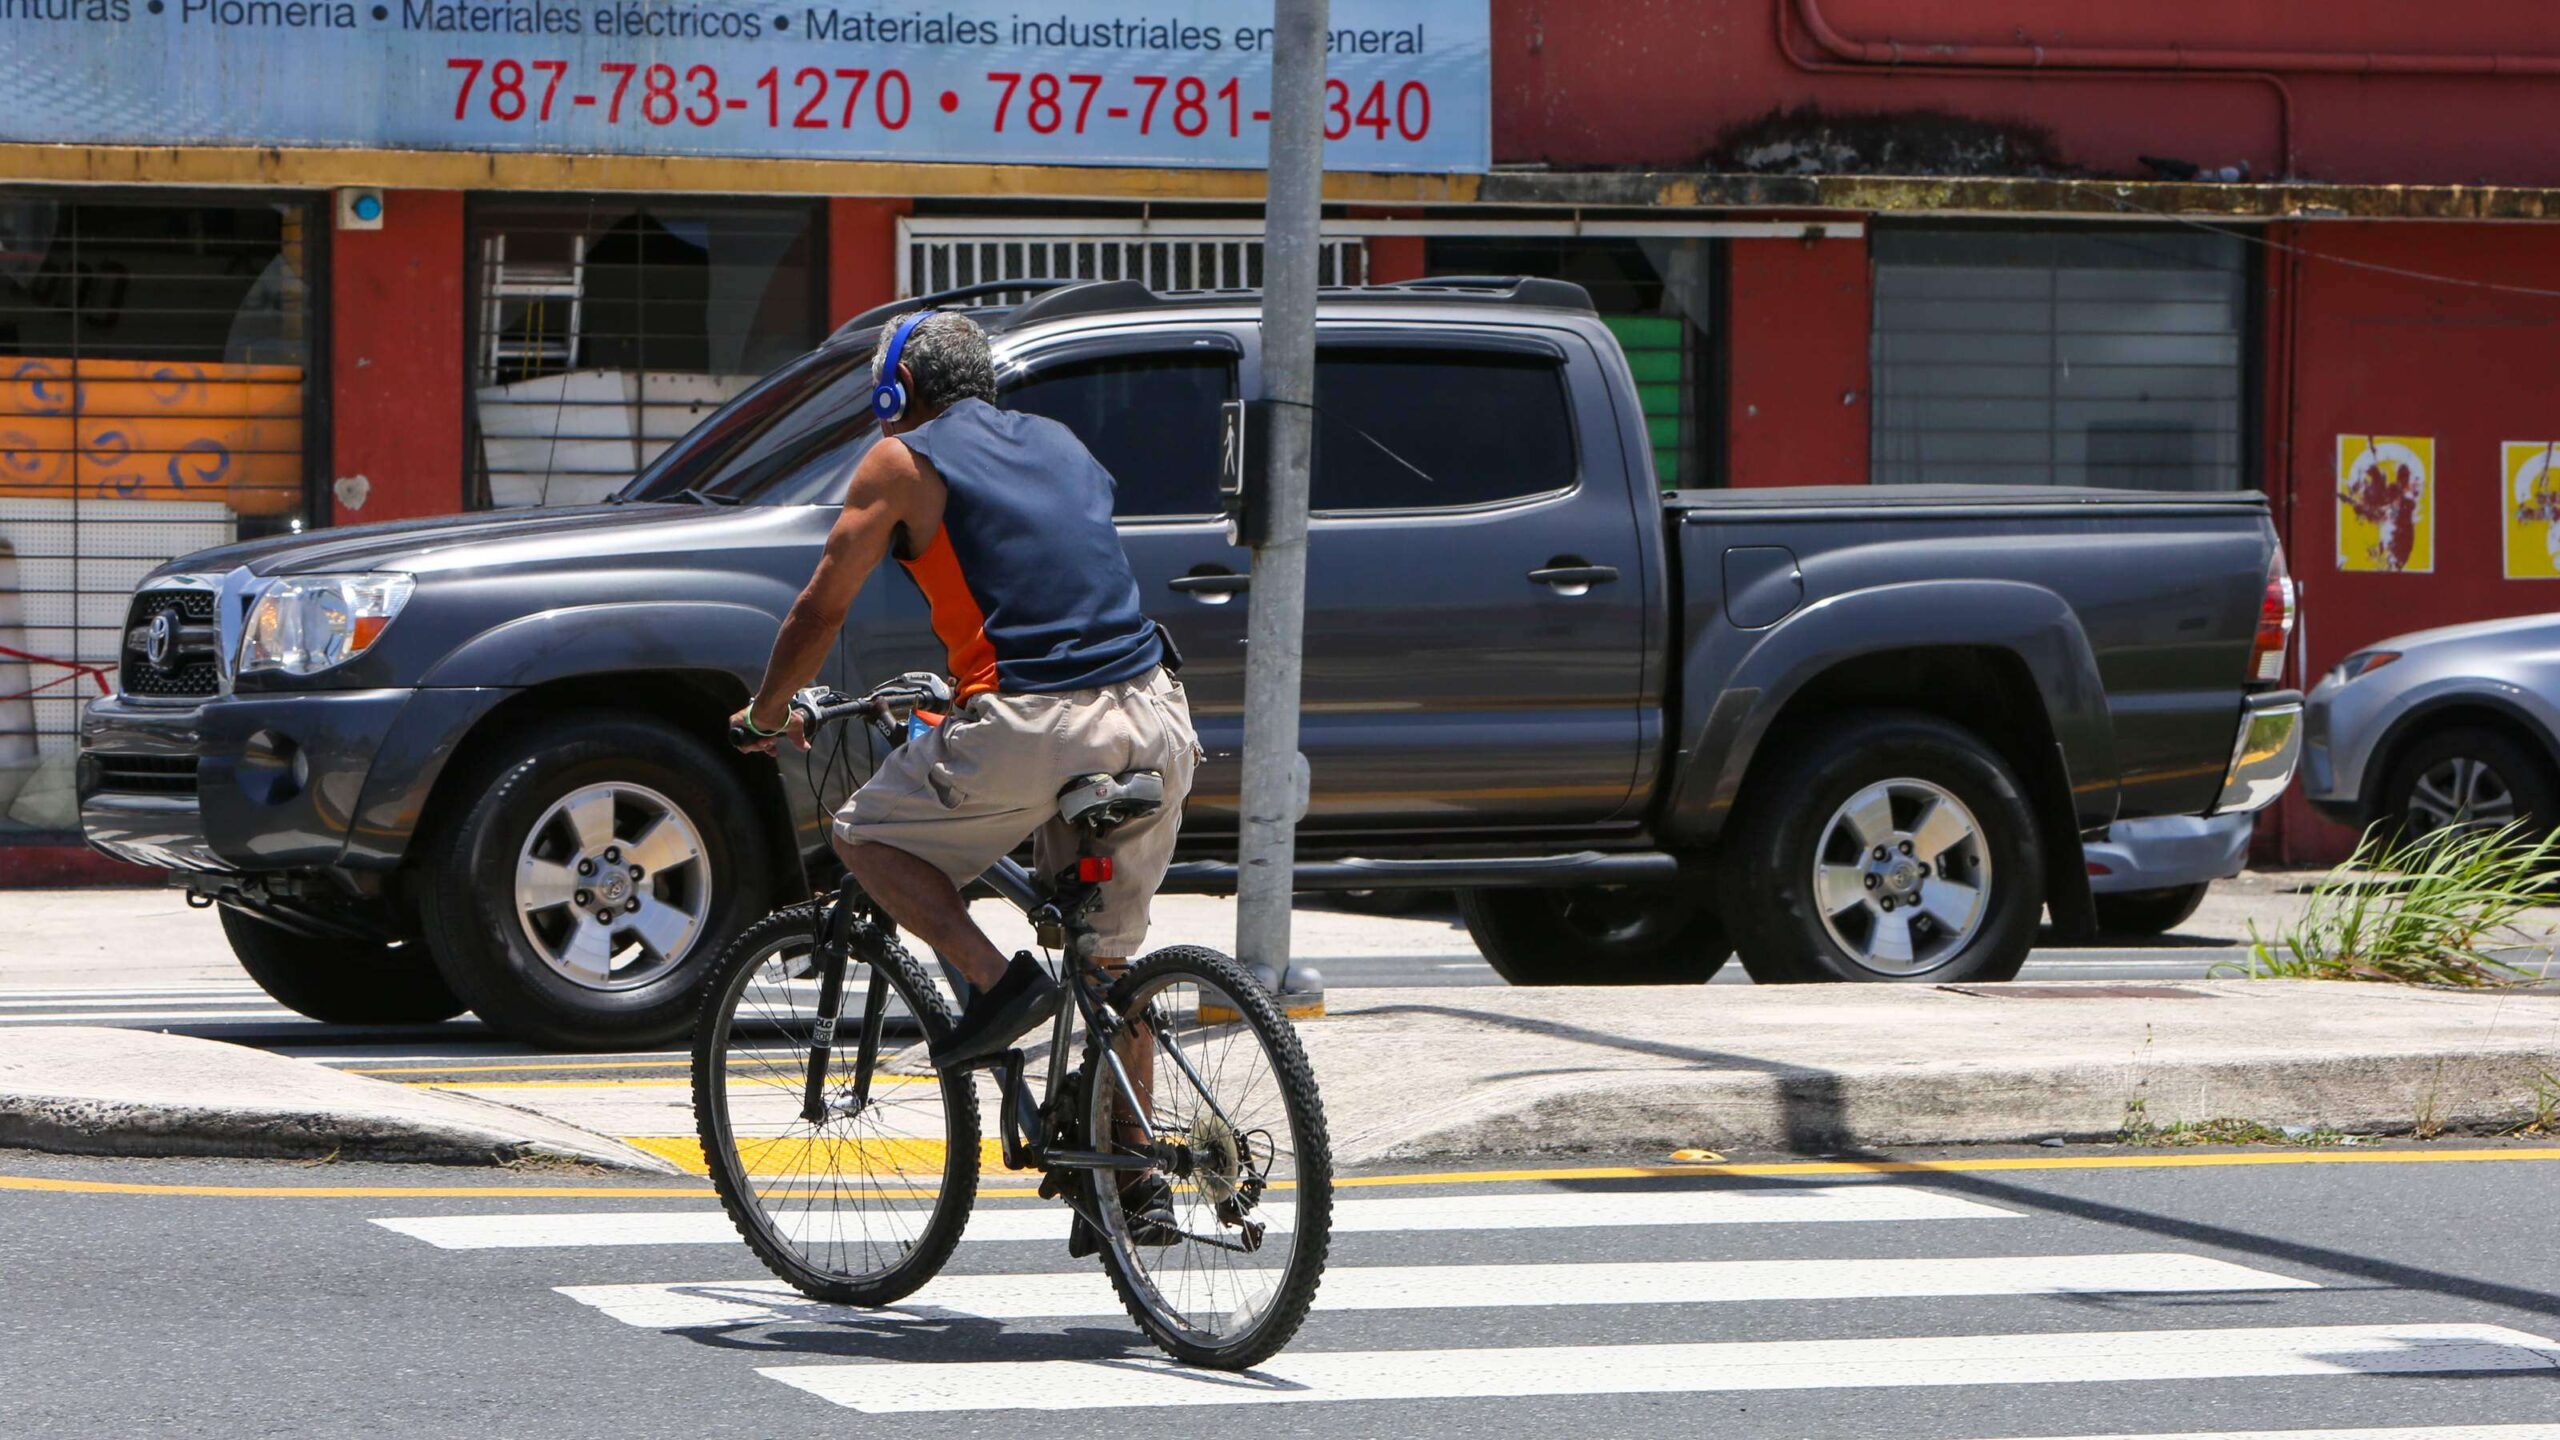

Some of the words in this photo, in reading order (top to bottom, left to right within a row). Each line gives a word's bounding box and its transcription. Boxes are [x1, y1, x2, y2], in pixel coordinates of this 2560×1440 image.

[0, 0, 131, 22] nturas
[402, 0, 582, 34] Materiales
[594, 1, 762, 38] eléctricos
[805, 8, 999, 45] Materiales
[1011, 14, 1222, 50] industriales
[1235, 27, 1275, 51] en
[448, 59, 911, 130] 787-783-1270
[988, 72, 1430, 141] 787-781-340
